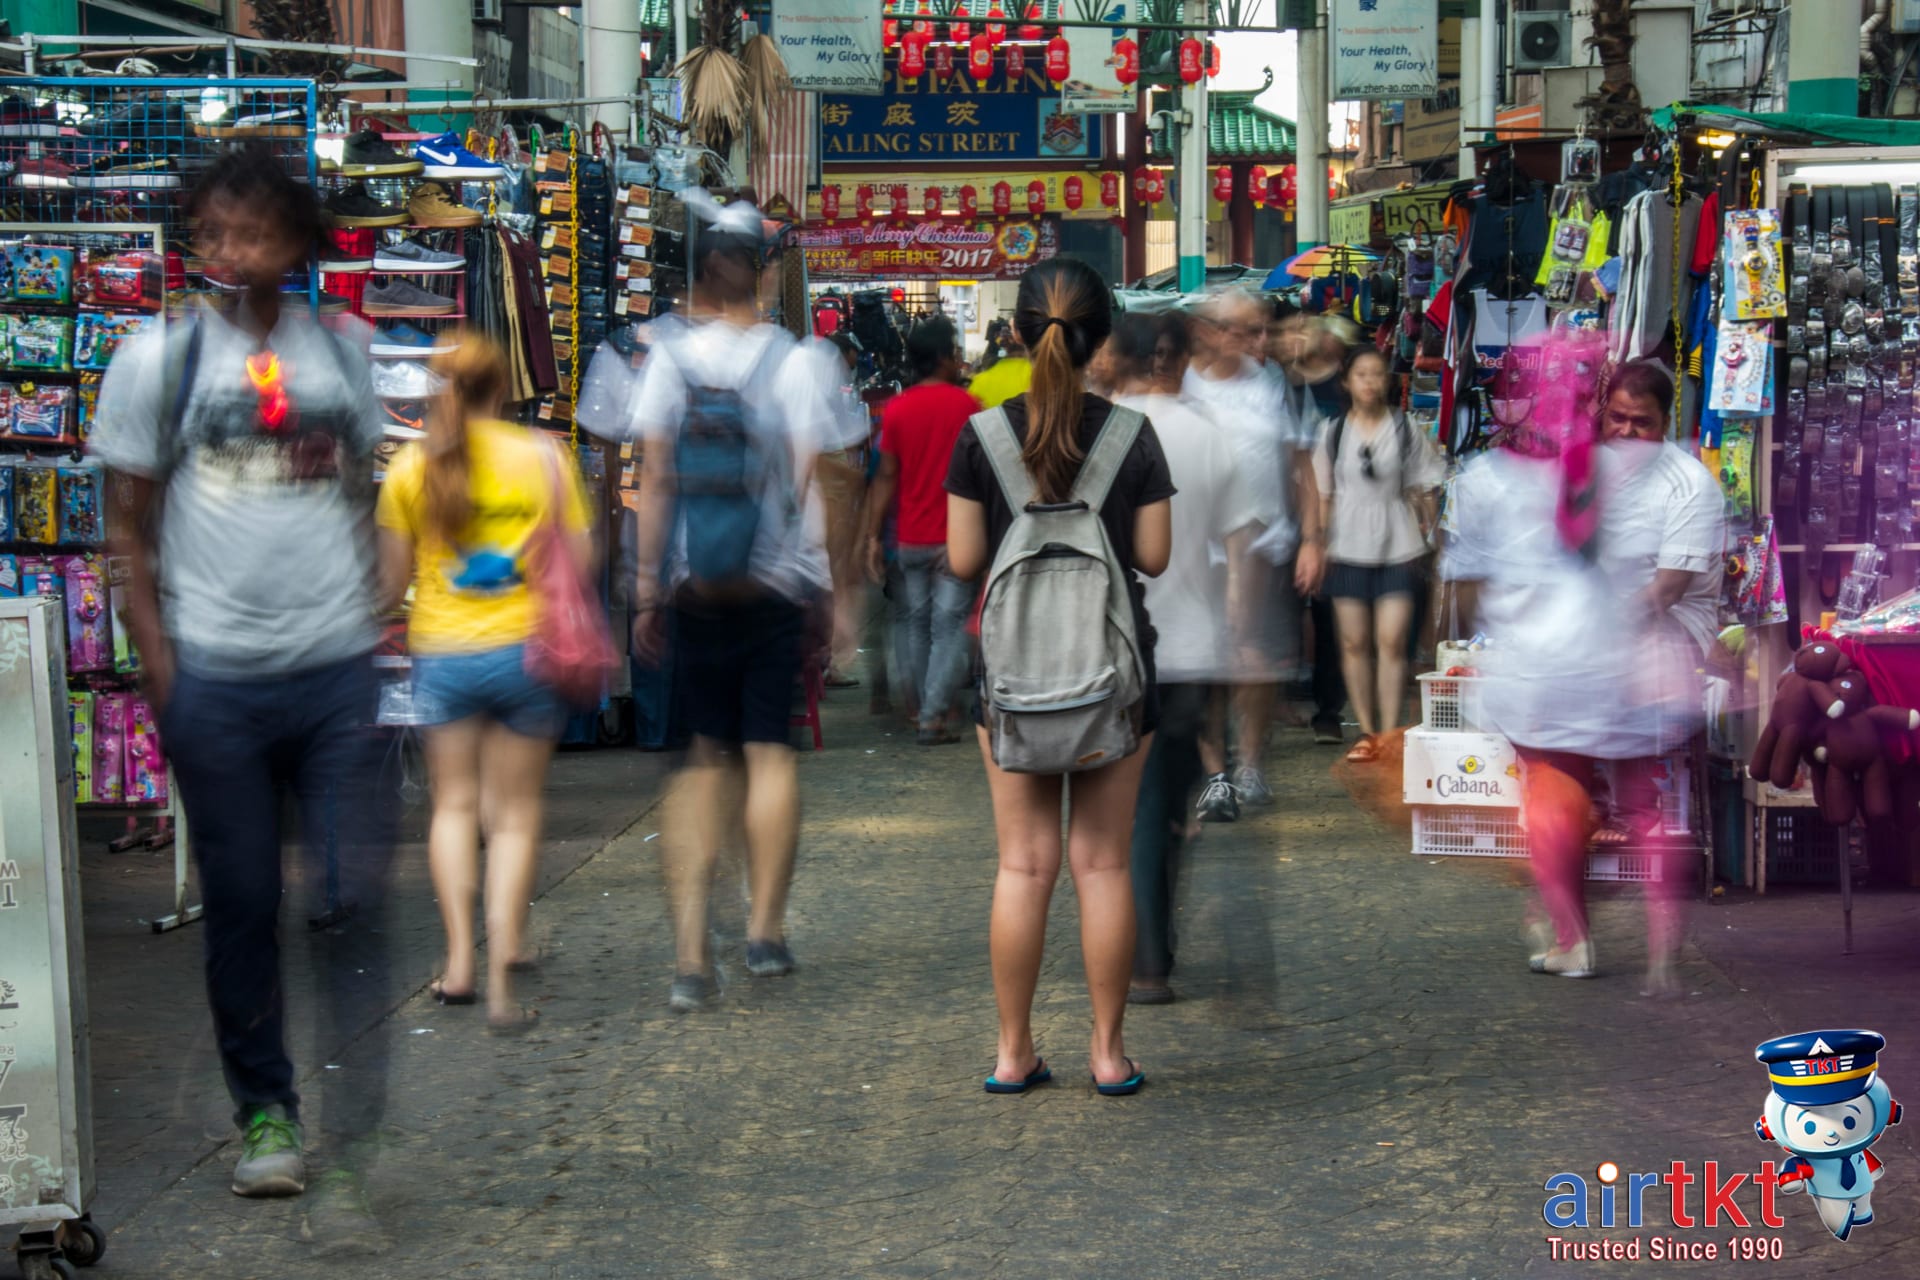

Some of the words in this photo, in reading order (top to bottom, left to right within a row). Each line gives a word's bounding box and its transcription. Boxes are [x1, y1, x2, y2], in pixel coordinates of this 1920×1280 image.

[780, 35, 807, 46] Your
[811, 35, 856, 47] Health,
[1340, 47, 1365, 57] Your
[1369, 44, 1411, 57] Health,
[816, 51, 834, 64] My
[838, 50, 871, 64] Glory
[1374, 60, 1391, 72] My
[1394, 59, 1426, 72] Glory
[823, 133, 911, 152] ALING
[918, 132, 1020, 152] STREET
[1388, 202, 1444, 226] HOT
[865, 222, 914, 249] Merry
[914, 221, 994, 244] Christmas
[941, 249, 994, 268] 2017
[1436, 774, 1502, 798] Cabana
